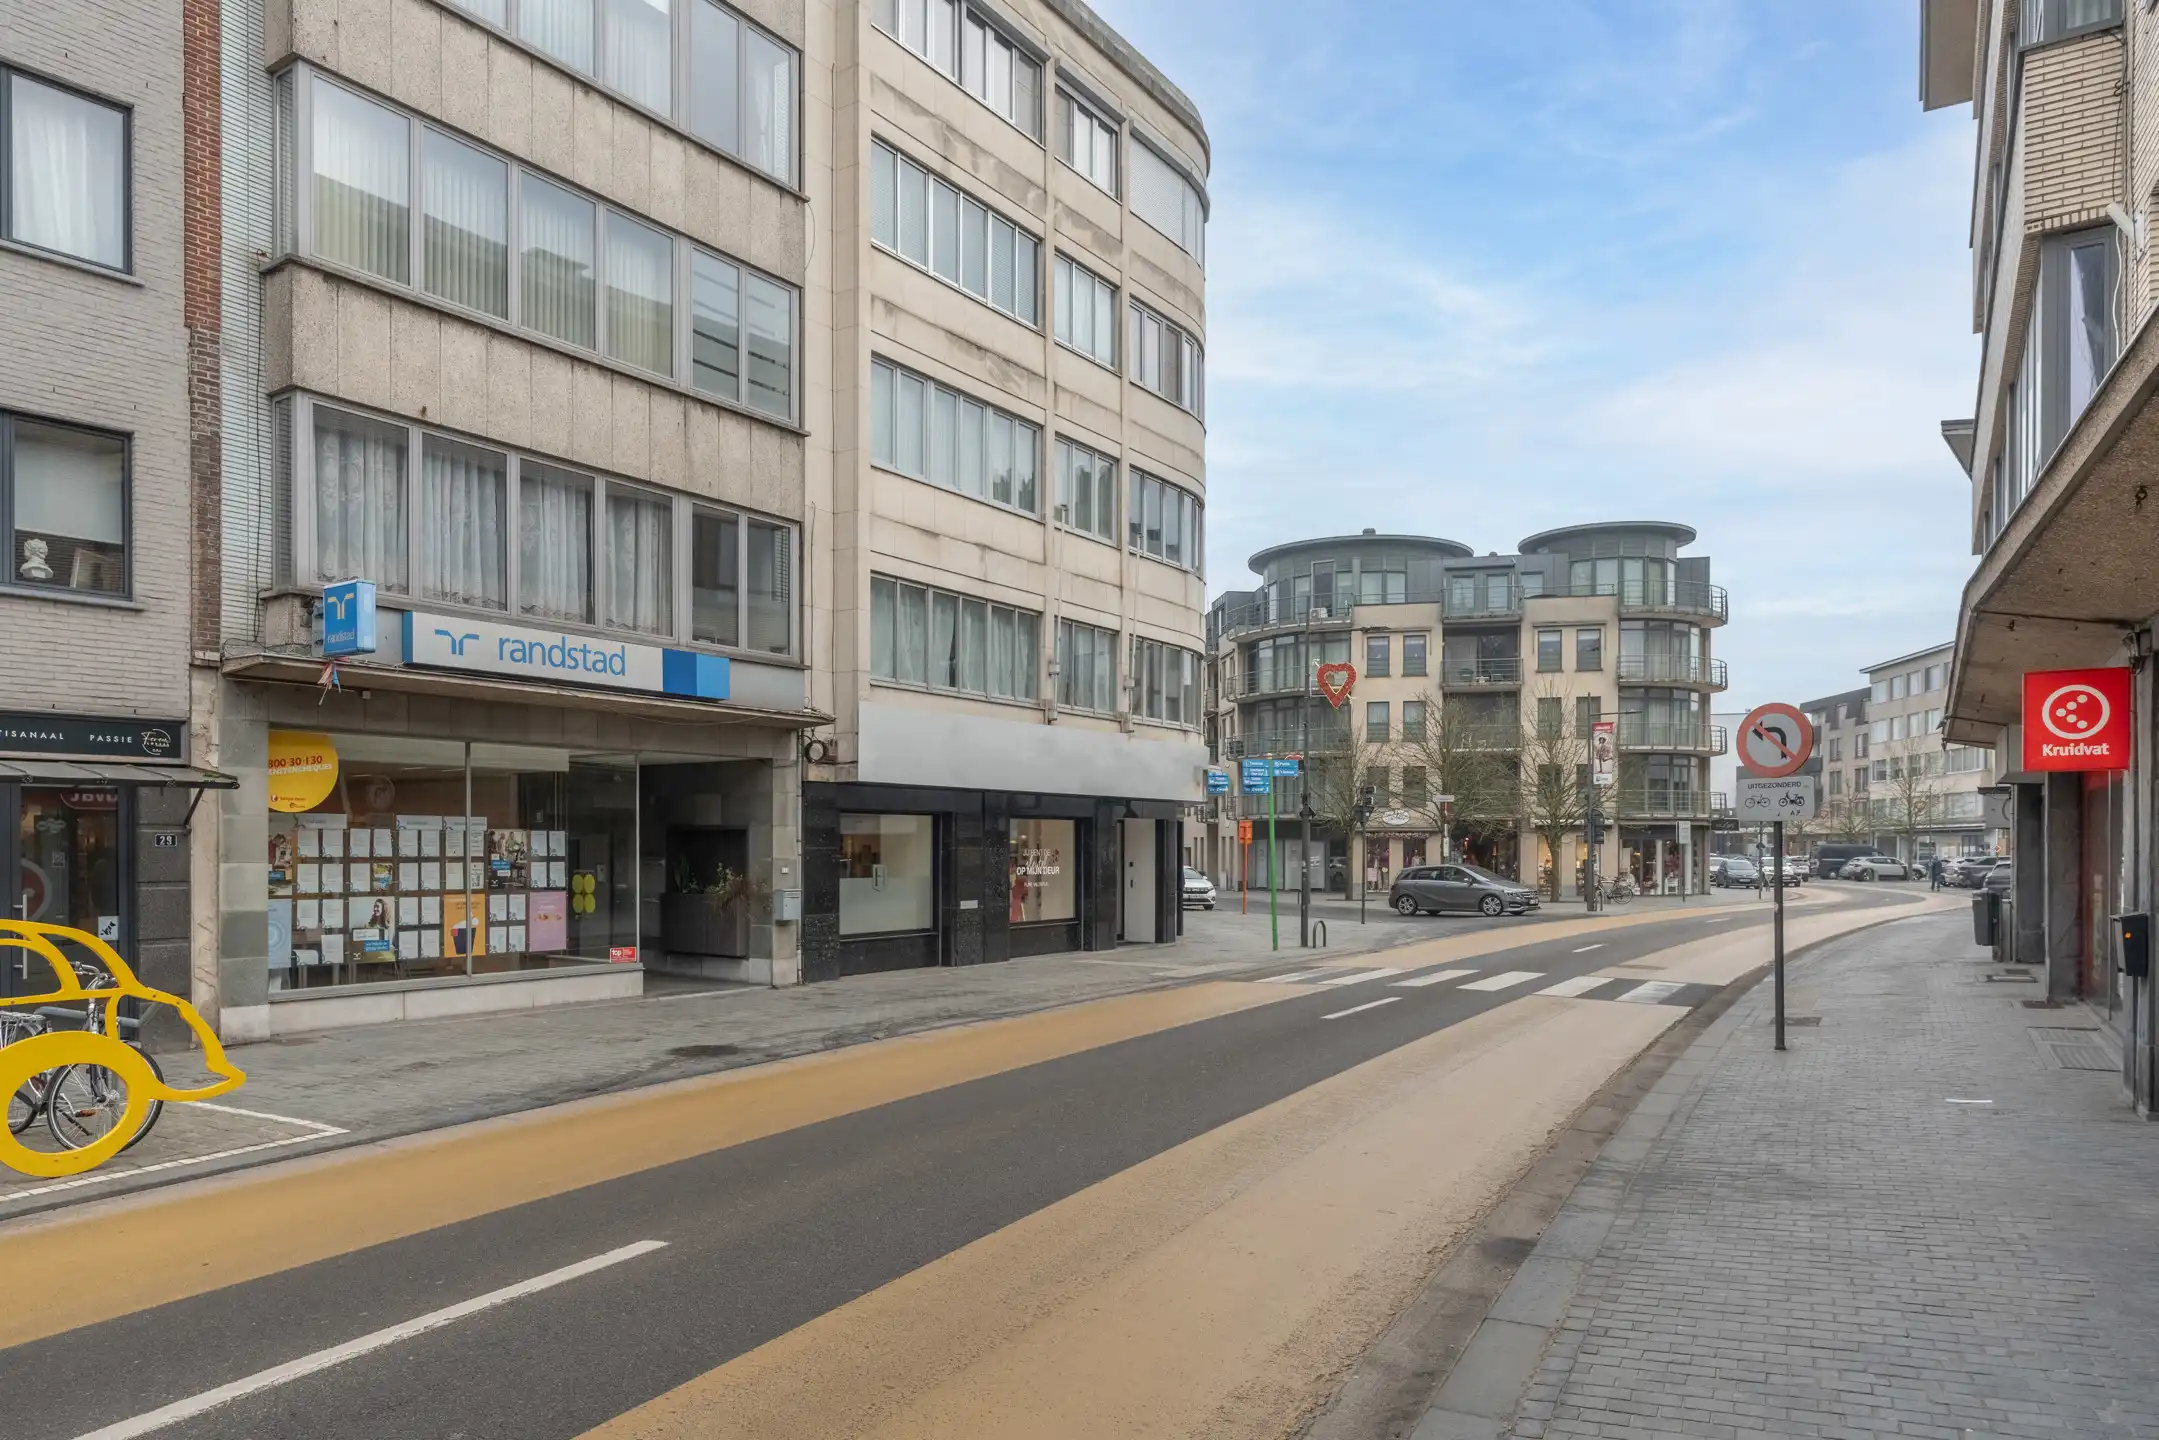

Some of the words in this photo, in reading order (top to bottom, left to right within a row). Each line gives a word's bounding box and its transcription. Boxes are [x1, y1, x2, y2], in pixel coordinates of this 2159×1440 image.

[499, 636, 626, 677] randstad
[89, 734, 133, 744] PASSIE
[2042, 742, 2110, 757] Kruidvat
[1747, 781, 1802, 790] UITGEZONDERD
[1016, 866, 1026, 876] OP
[1043, 866, 1060, 875] DEUR
